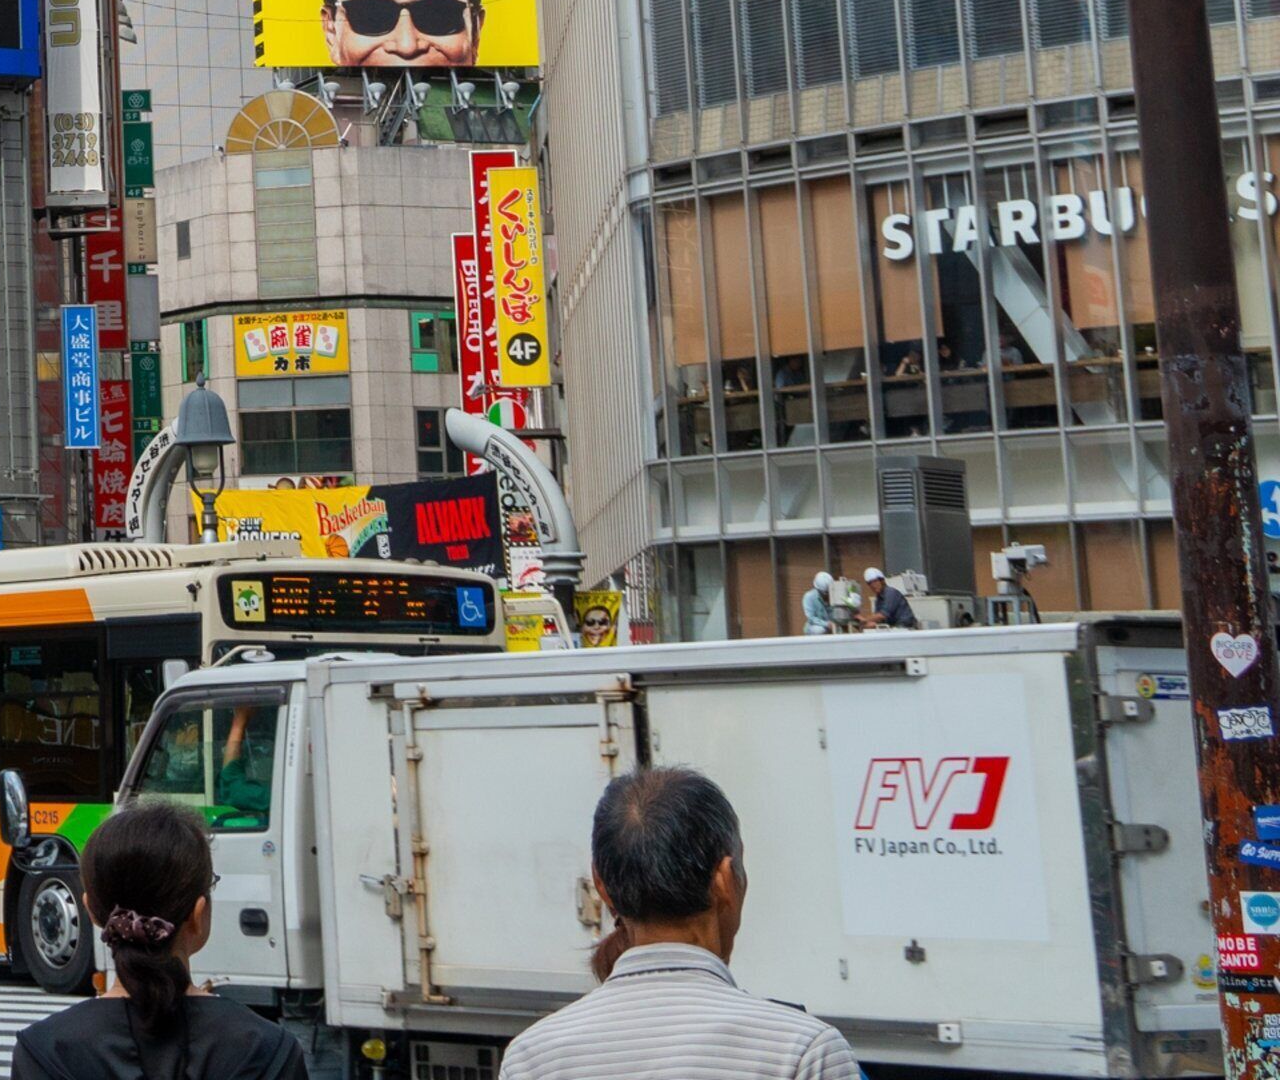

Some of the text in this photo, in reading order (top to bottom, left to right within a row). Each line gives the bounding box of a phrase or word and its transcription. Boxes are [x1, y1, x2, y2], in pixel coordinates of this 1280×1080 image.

[51, 131, 98, 151] 3719
[51, 149, 100, 168] 2468
[127, 188, 141, 197] 4F
[881, 171, 1279, 262] STARBUS
[130, 264, 145, 274] 3F
[269, 325, 312, 349] 麻雀
[132, 342, 148, 352] 2F
[508, 338, 539, 361] 4F
[70, 313, 93, 442] 大盛堂商事ビル
[127, 432, 171, 534] 渋谷センター街
[239, 516, 264, 531] SUN
[314, 497, 387, 537] Basketball
[1215, 639, 1254, 650] BIGGER
[1215, 648, 1254, 661] LOVE
[854, 837, 1004, 858] FV Japan Co., Ltd.
[1220, 953, 1259, 968] SANTO
